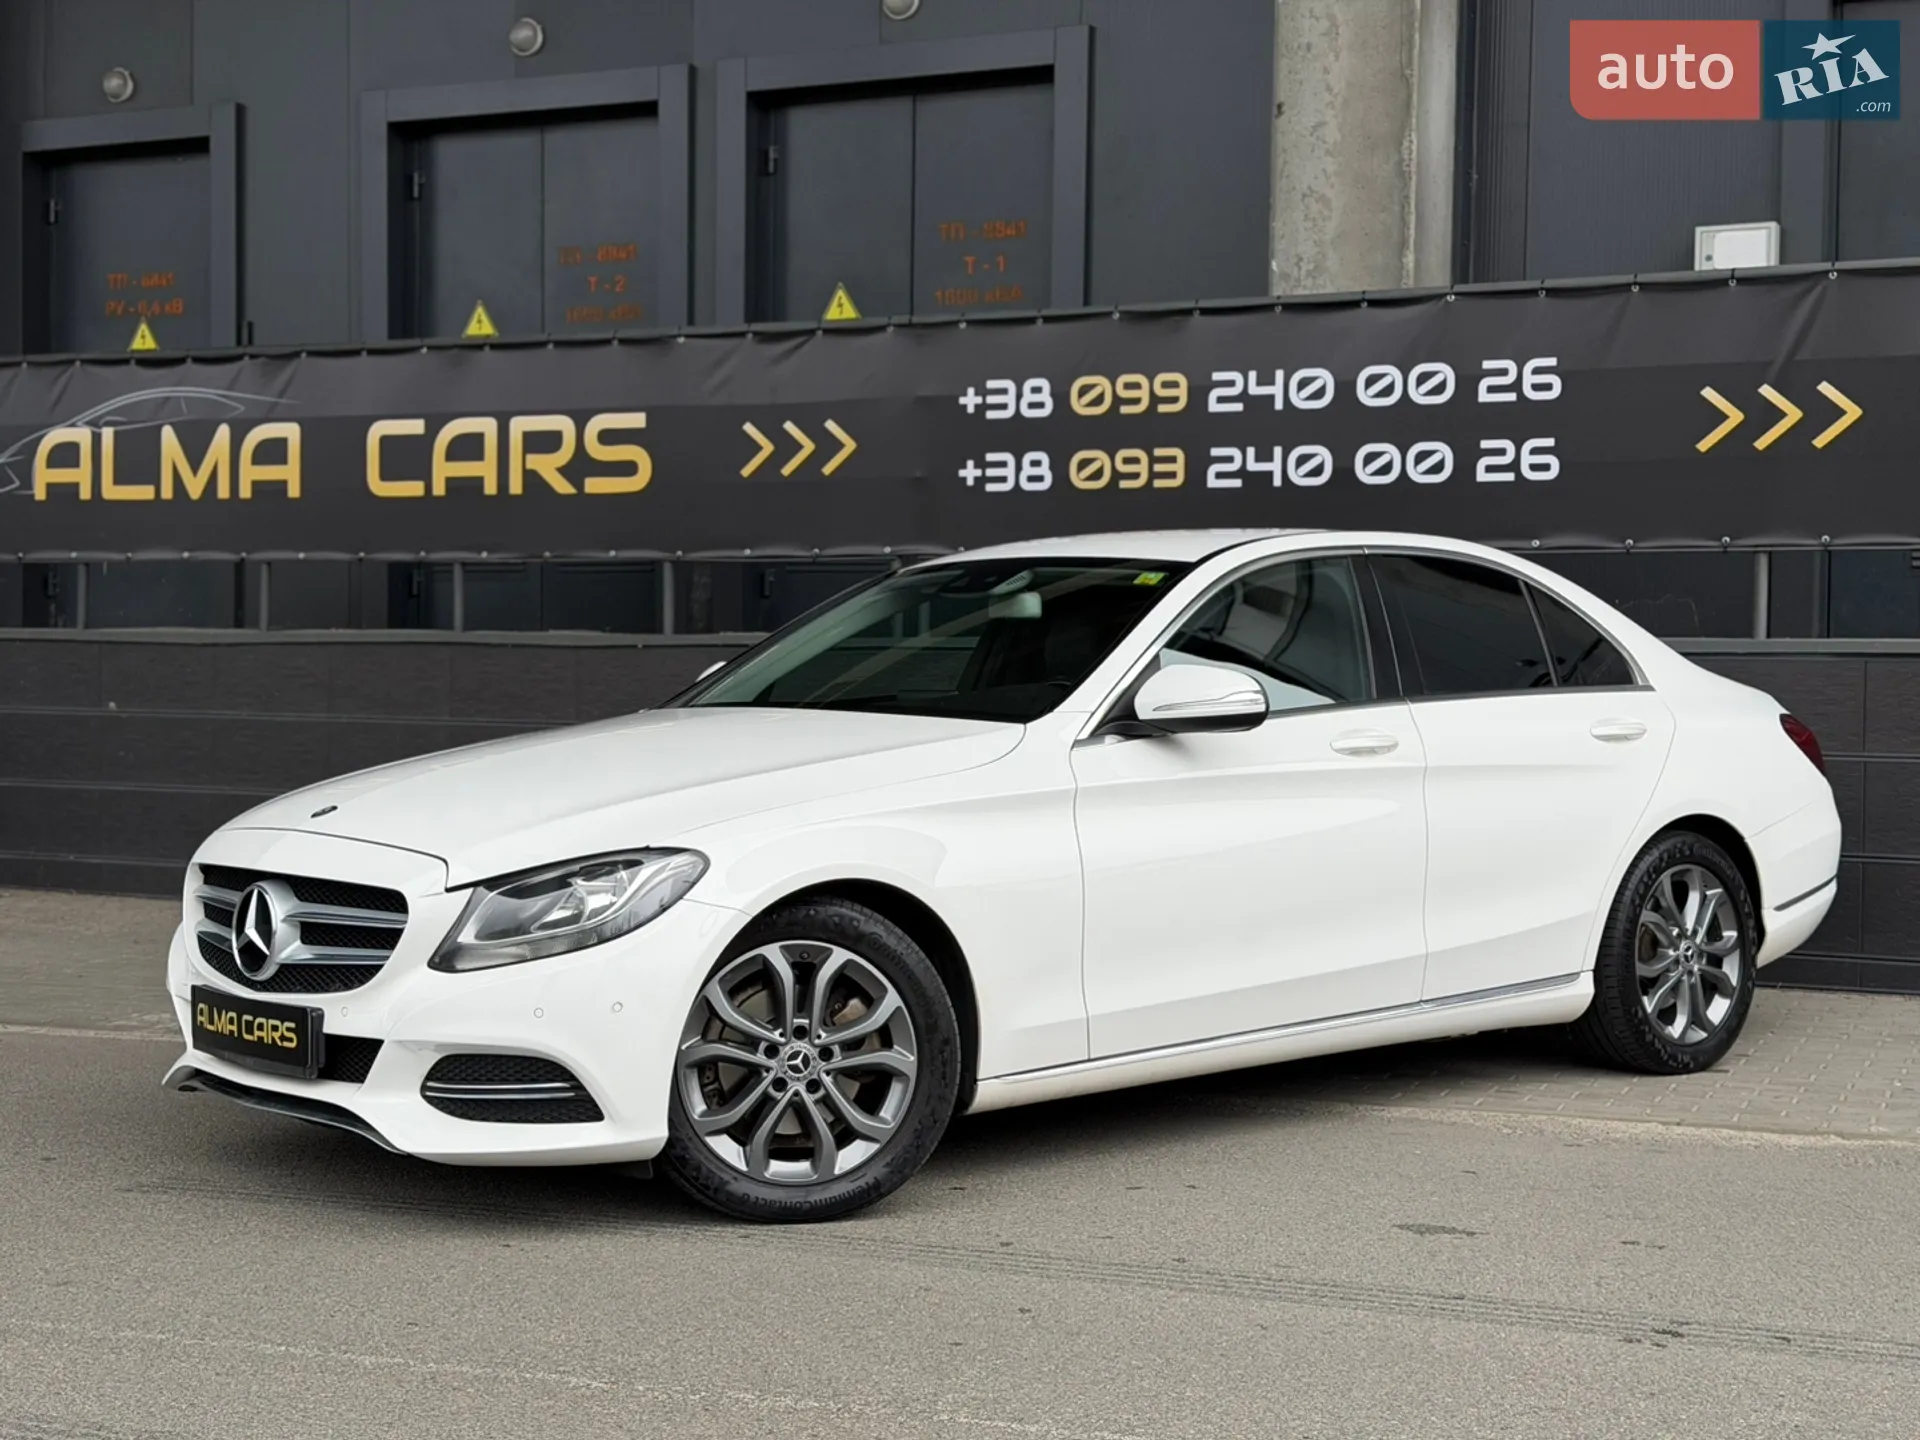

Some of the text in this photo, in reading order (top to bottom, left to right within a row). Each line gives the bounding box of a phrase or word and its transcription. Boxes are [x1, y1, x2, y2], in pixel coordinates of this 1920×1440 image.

[958, 356, 1562, 420] +38 099 240 00 26
[33, 412, 652, 501] ALMA CARS
[958, 437, 1560, 492] +38 093 240 00 26
[197, 1002, 298, 1049] ALMA CARS
